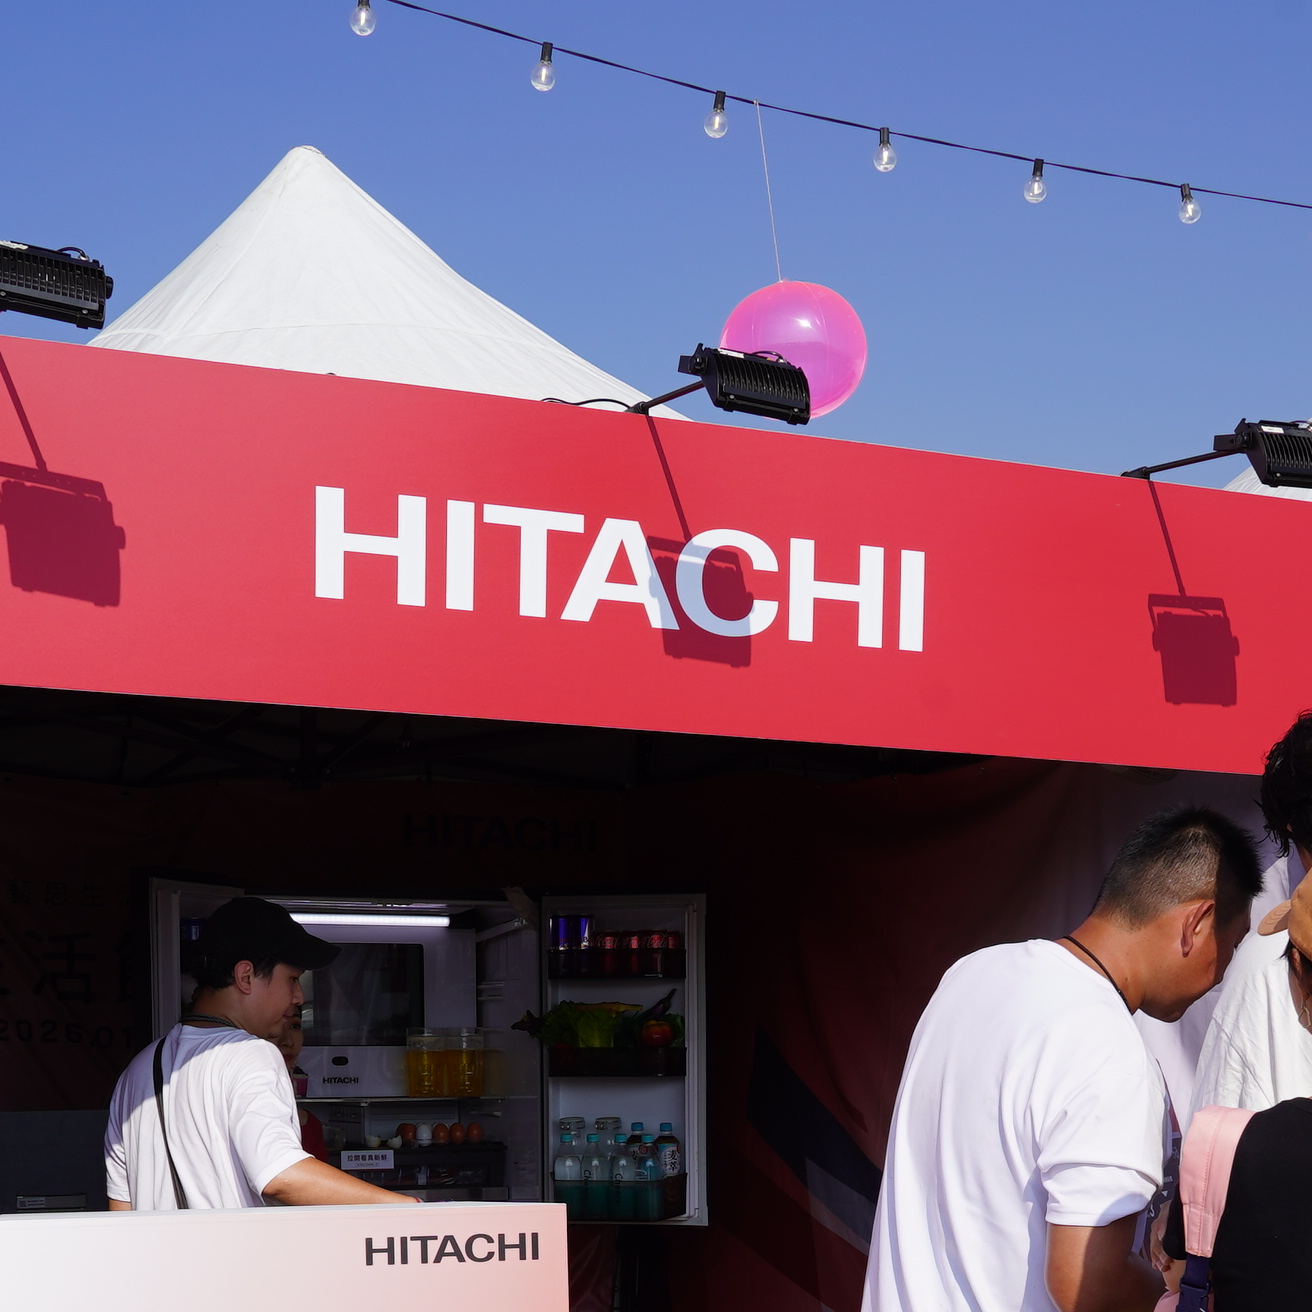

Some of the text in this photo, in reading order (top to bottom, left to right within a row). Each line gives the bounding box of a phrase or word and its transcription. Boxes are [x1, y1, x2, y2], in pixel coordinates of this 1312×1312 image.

[315, 485, 925, 652] HITACHI
[348, 1154, 387, 1162] 拉開看真新鮮
[364, 1232, 540, 1266] HITACHI
